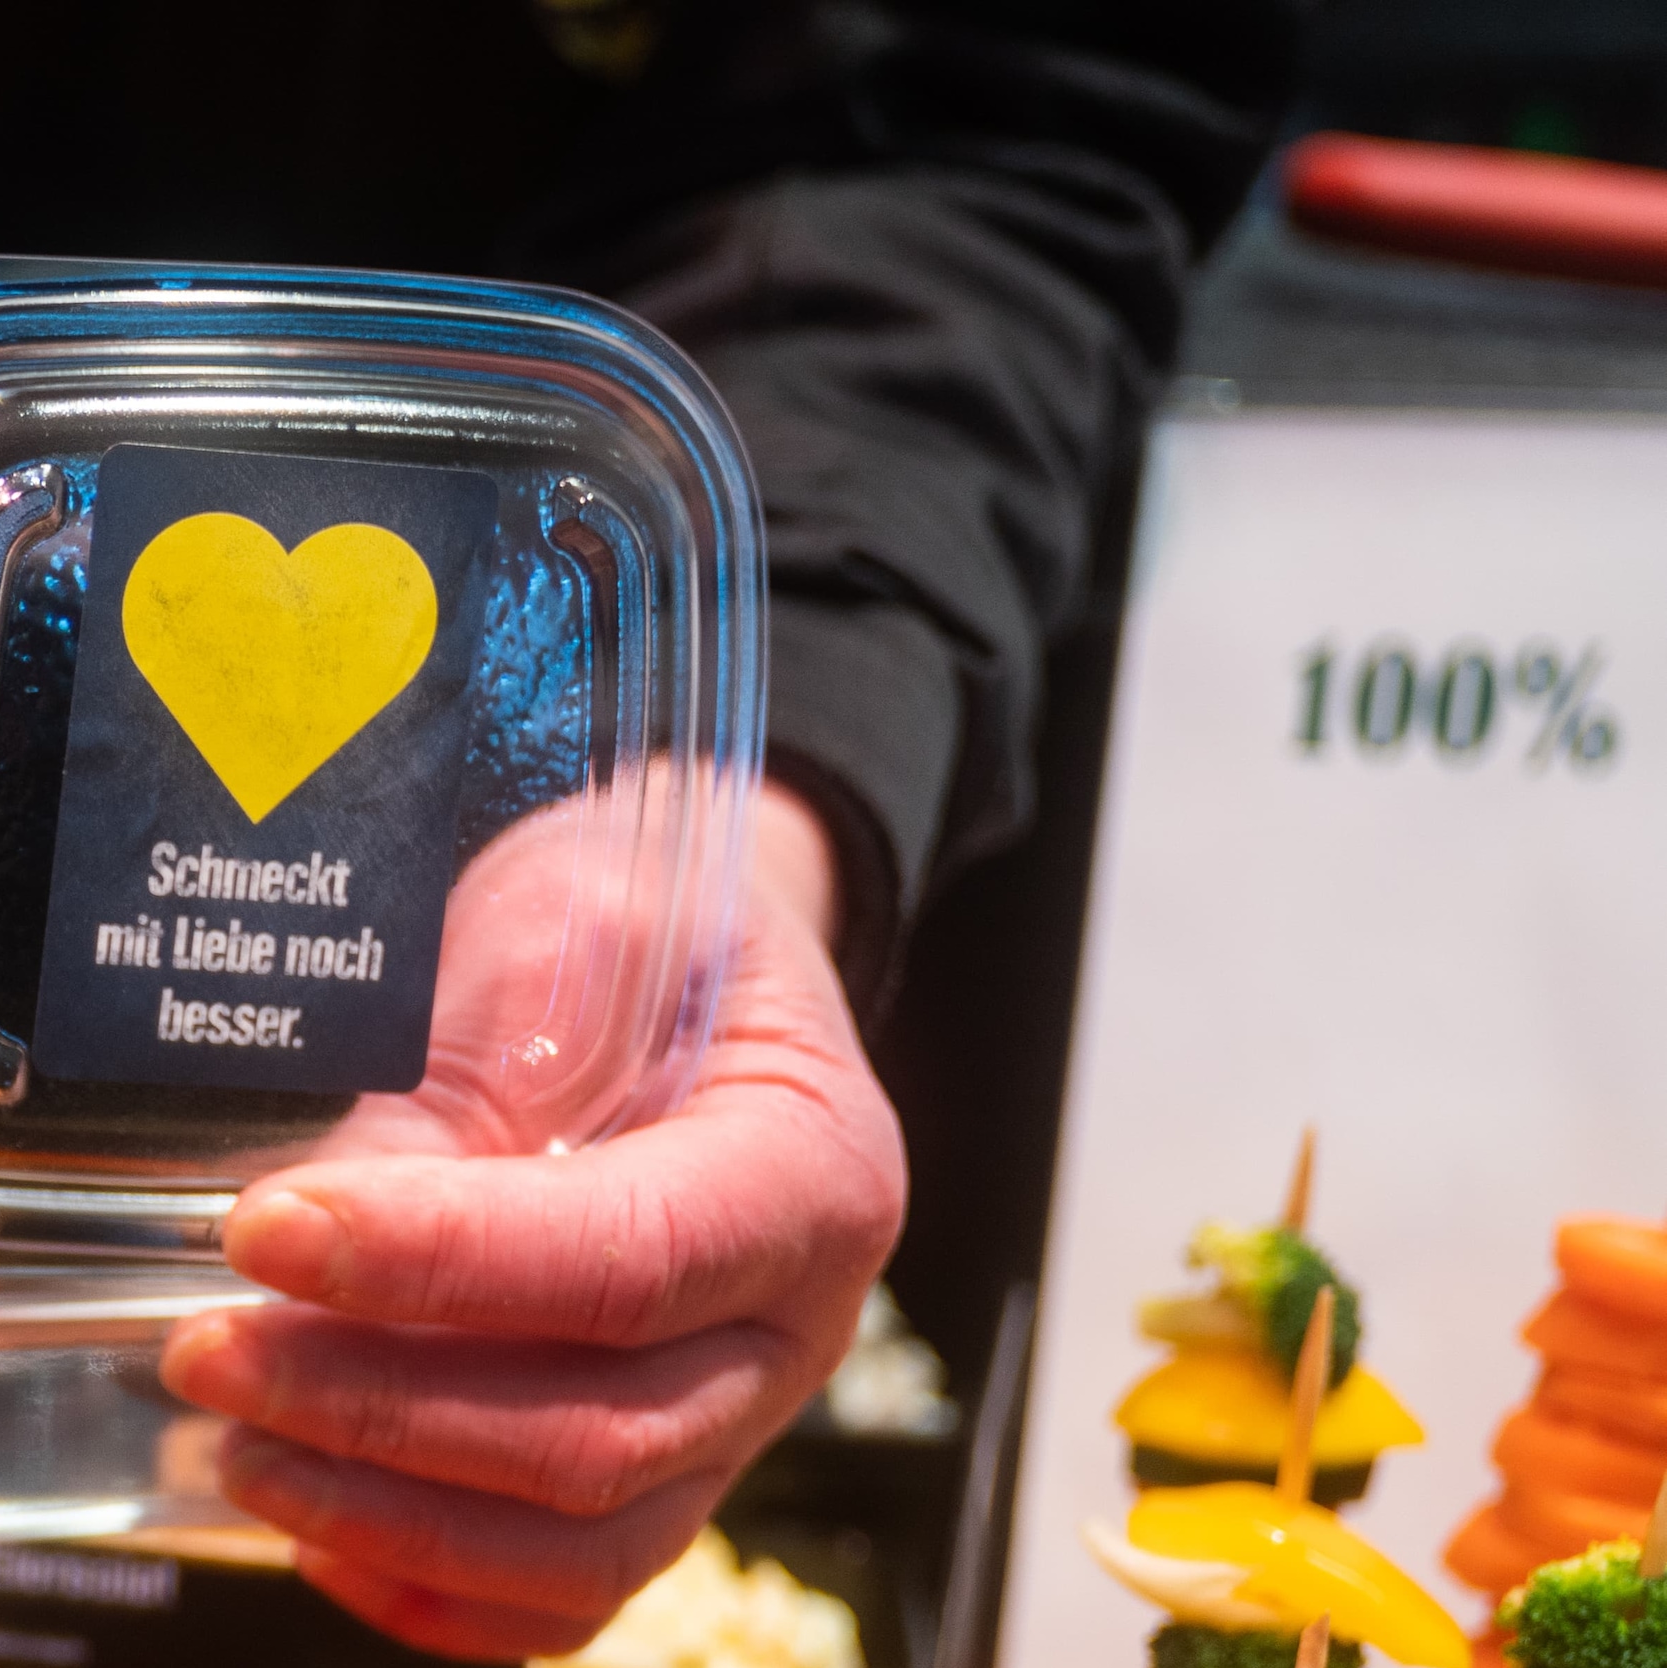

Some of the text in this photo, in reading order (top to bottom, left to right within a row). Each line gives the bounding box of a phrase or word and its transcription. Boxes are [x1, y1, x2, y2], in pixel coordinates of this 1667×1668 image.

[1289, 632, 1620, 777] 100%
[147, 841, 351, 907] Schmeckt
[96, 914, 384, 982] mit Liebe noch
[158, 989, 304, 1048] besser.
